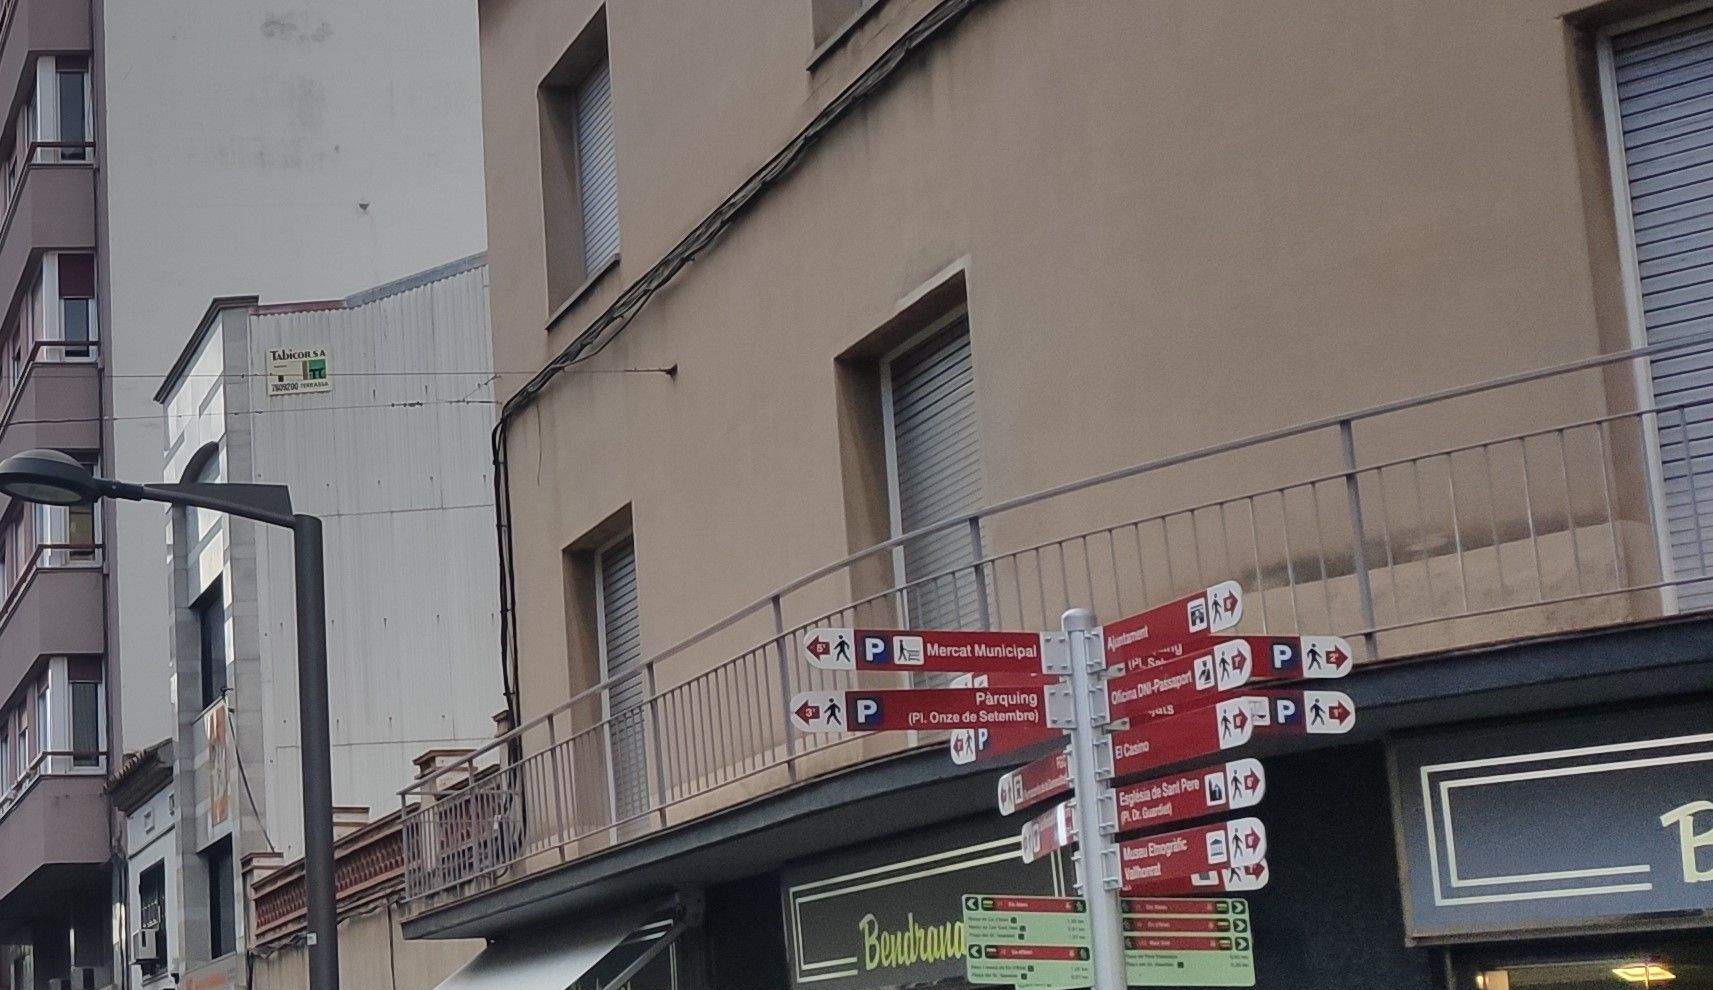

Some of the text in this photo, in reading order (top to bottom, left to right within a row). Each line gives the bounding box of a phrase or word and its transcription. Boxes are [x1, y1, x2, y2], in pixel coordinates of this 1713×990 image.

[1107, 626, 1149, 652] Ajuntament
[927, 643, 972, 657] Mercat
[974, 643, 1037, 659] Municipal
[1273, 645, 1292, 669] P
[976, 692, 1037, 707] Pàrquing
[930, 712, 959, 723] Onze
[962, 712, 977, 723] de
[979, 711, 1039, 723] Setembre)
[1277, 700, 1295, 724] P
[1115, 740, 1150, 760] El Casino
[1151, 784, 1162, 800] de
[1162, 780, 1179, 797] Sant
[1181, 777, 1200, 792] Pere
